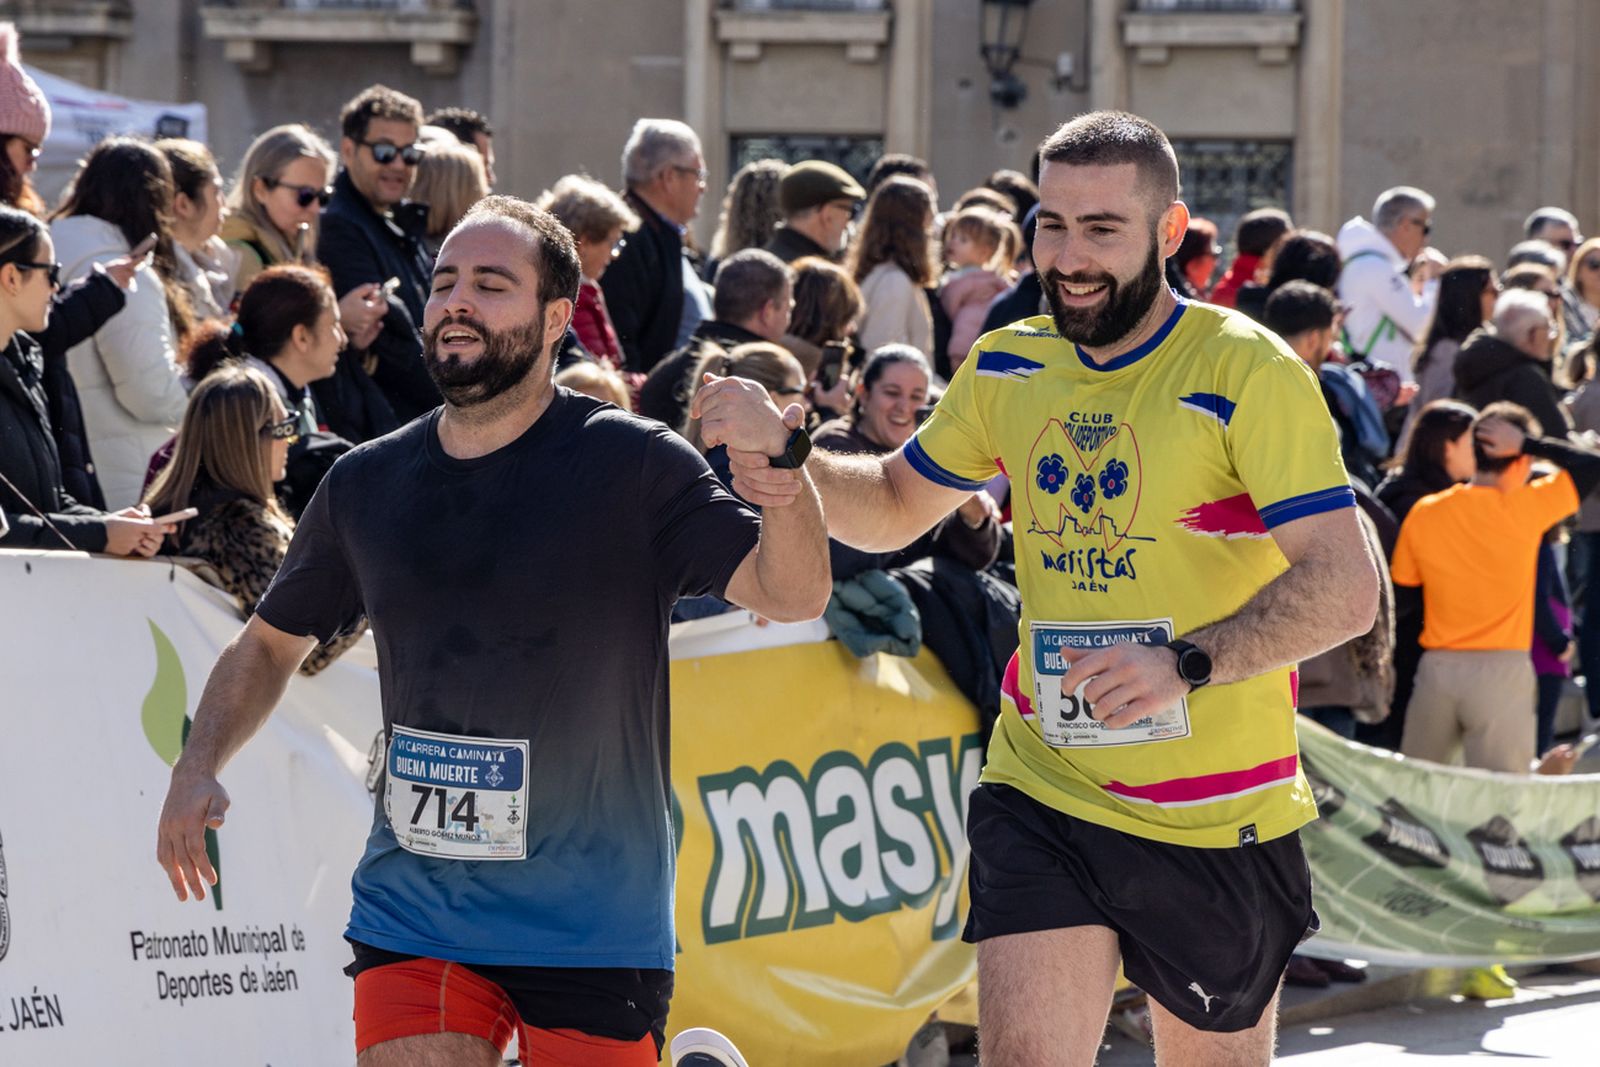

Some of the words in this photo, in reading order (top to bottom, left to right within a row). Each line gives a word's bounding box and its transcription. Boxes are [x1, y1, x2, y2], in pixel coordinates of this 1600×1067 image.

[1069, 411, 1113, 424] CLUB
[1040, 547, 1136, 580] maristas
[1071, 579, 1108, 593] JAÉN
[1042, 635, 1051, 645] VI
[1052, 634, 1092, 647] CARRERA
[1057, 721, 1088, 729] FRANCISCO
[405, 741, 447, 757] CARRERA
[448, 747, 506, 763] CAMINATA
[396, 756, 426, 778] BUENA
[429, 761, 479, 784] MUERTE
[410, 784, 480, 832] 714
[409, 827, 431, 836] ALBERTO
[130, 929, 208, 961] Patronato
[212, 923, 287, 961] Municipal
[291, 923, 306, 951] de
[156, 968, 234, 1007] Deportes
[239, 964, 258, 994] de
[261, 961, 299, 993] Jaén
[9, 985, 64, 1032] JAÉN
